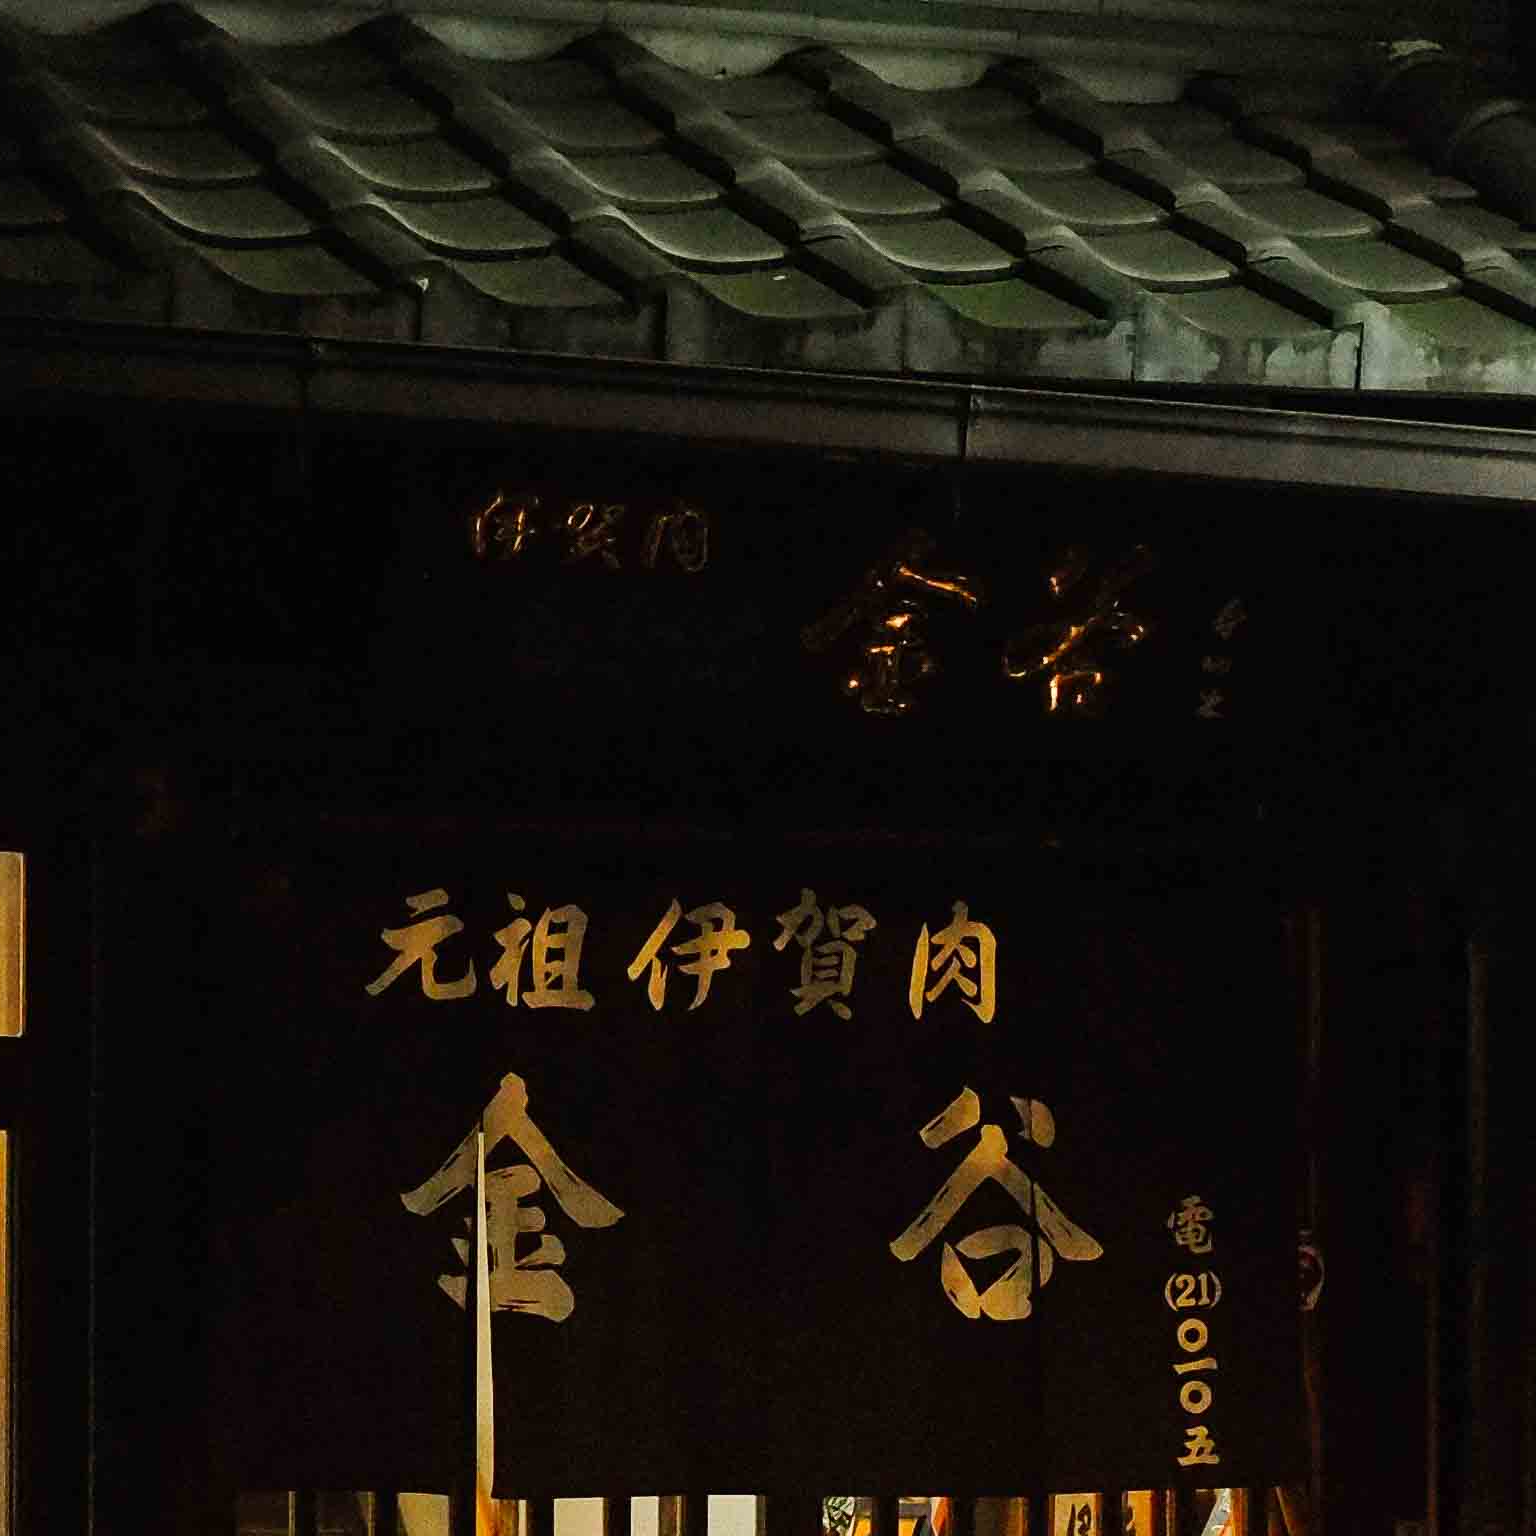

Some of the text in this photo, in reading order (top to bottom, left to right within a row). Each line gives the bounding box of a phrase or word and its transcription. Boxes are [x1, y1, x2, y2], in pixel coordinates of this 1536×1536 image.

[364, 887, 999, 1024] 元祖伊賀肉
[400, 1071, 1105, 1322] 金谷
